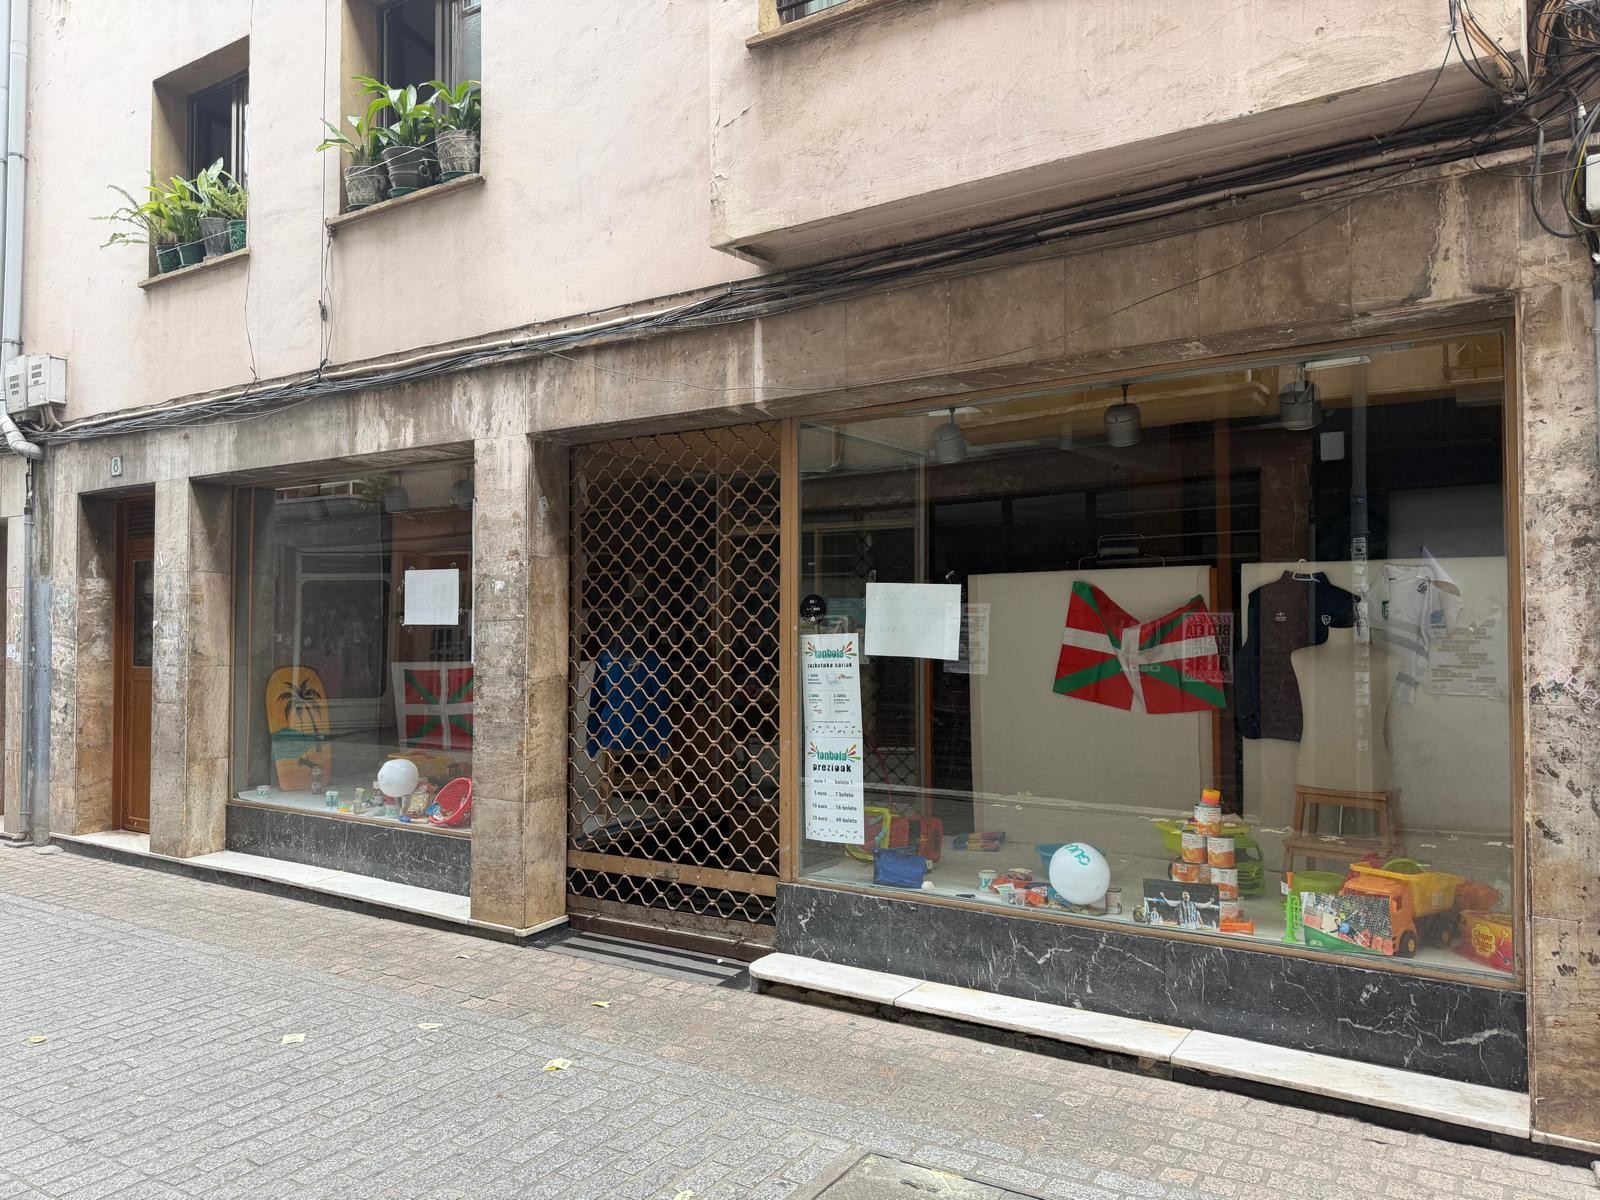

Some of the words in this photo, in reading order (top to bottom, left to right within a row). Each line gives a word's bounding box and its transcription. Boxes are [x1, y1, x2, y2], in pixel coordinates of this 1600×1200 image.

[113, 459, 119, 473] 8
[816, 750, 847, 761] tonbola
[813, 764, 852, 772] prezioak
